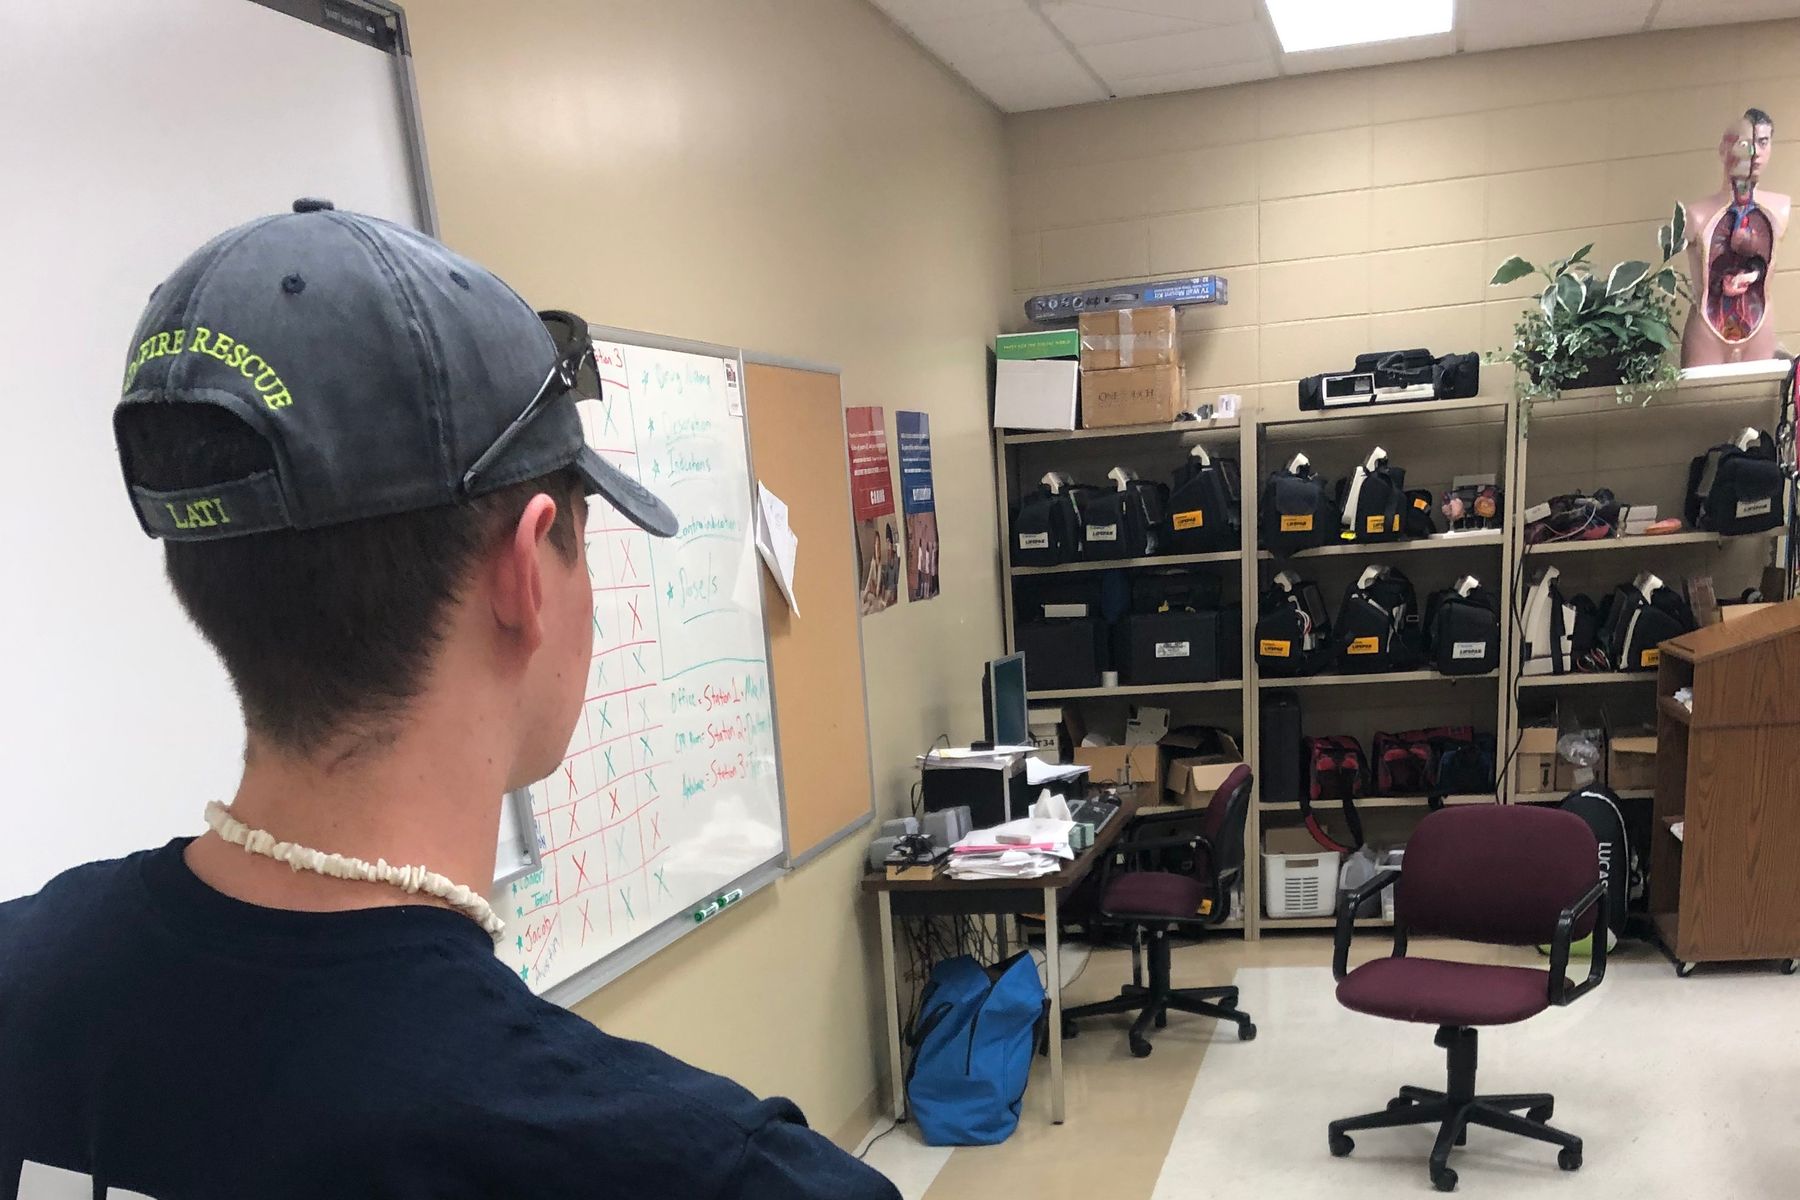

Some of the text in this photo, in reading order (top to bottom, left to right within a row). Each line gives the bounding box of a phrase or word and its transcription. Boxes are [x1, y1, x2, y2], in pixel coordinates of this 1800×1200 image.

[138, 329, 186, 366] FIRE
[189, 327, 294, 410] RESCUE
[166, 498, 231, 529] LATI
